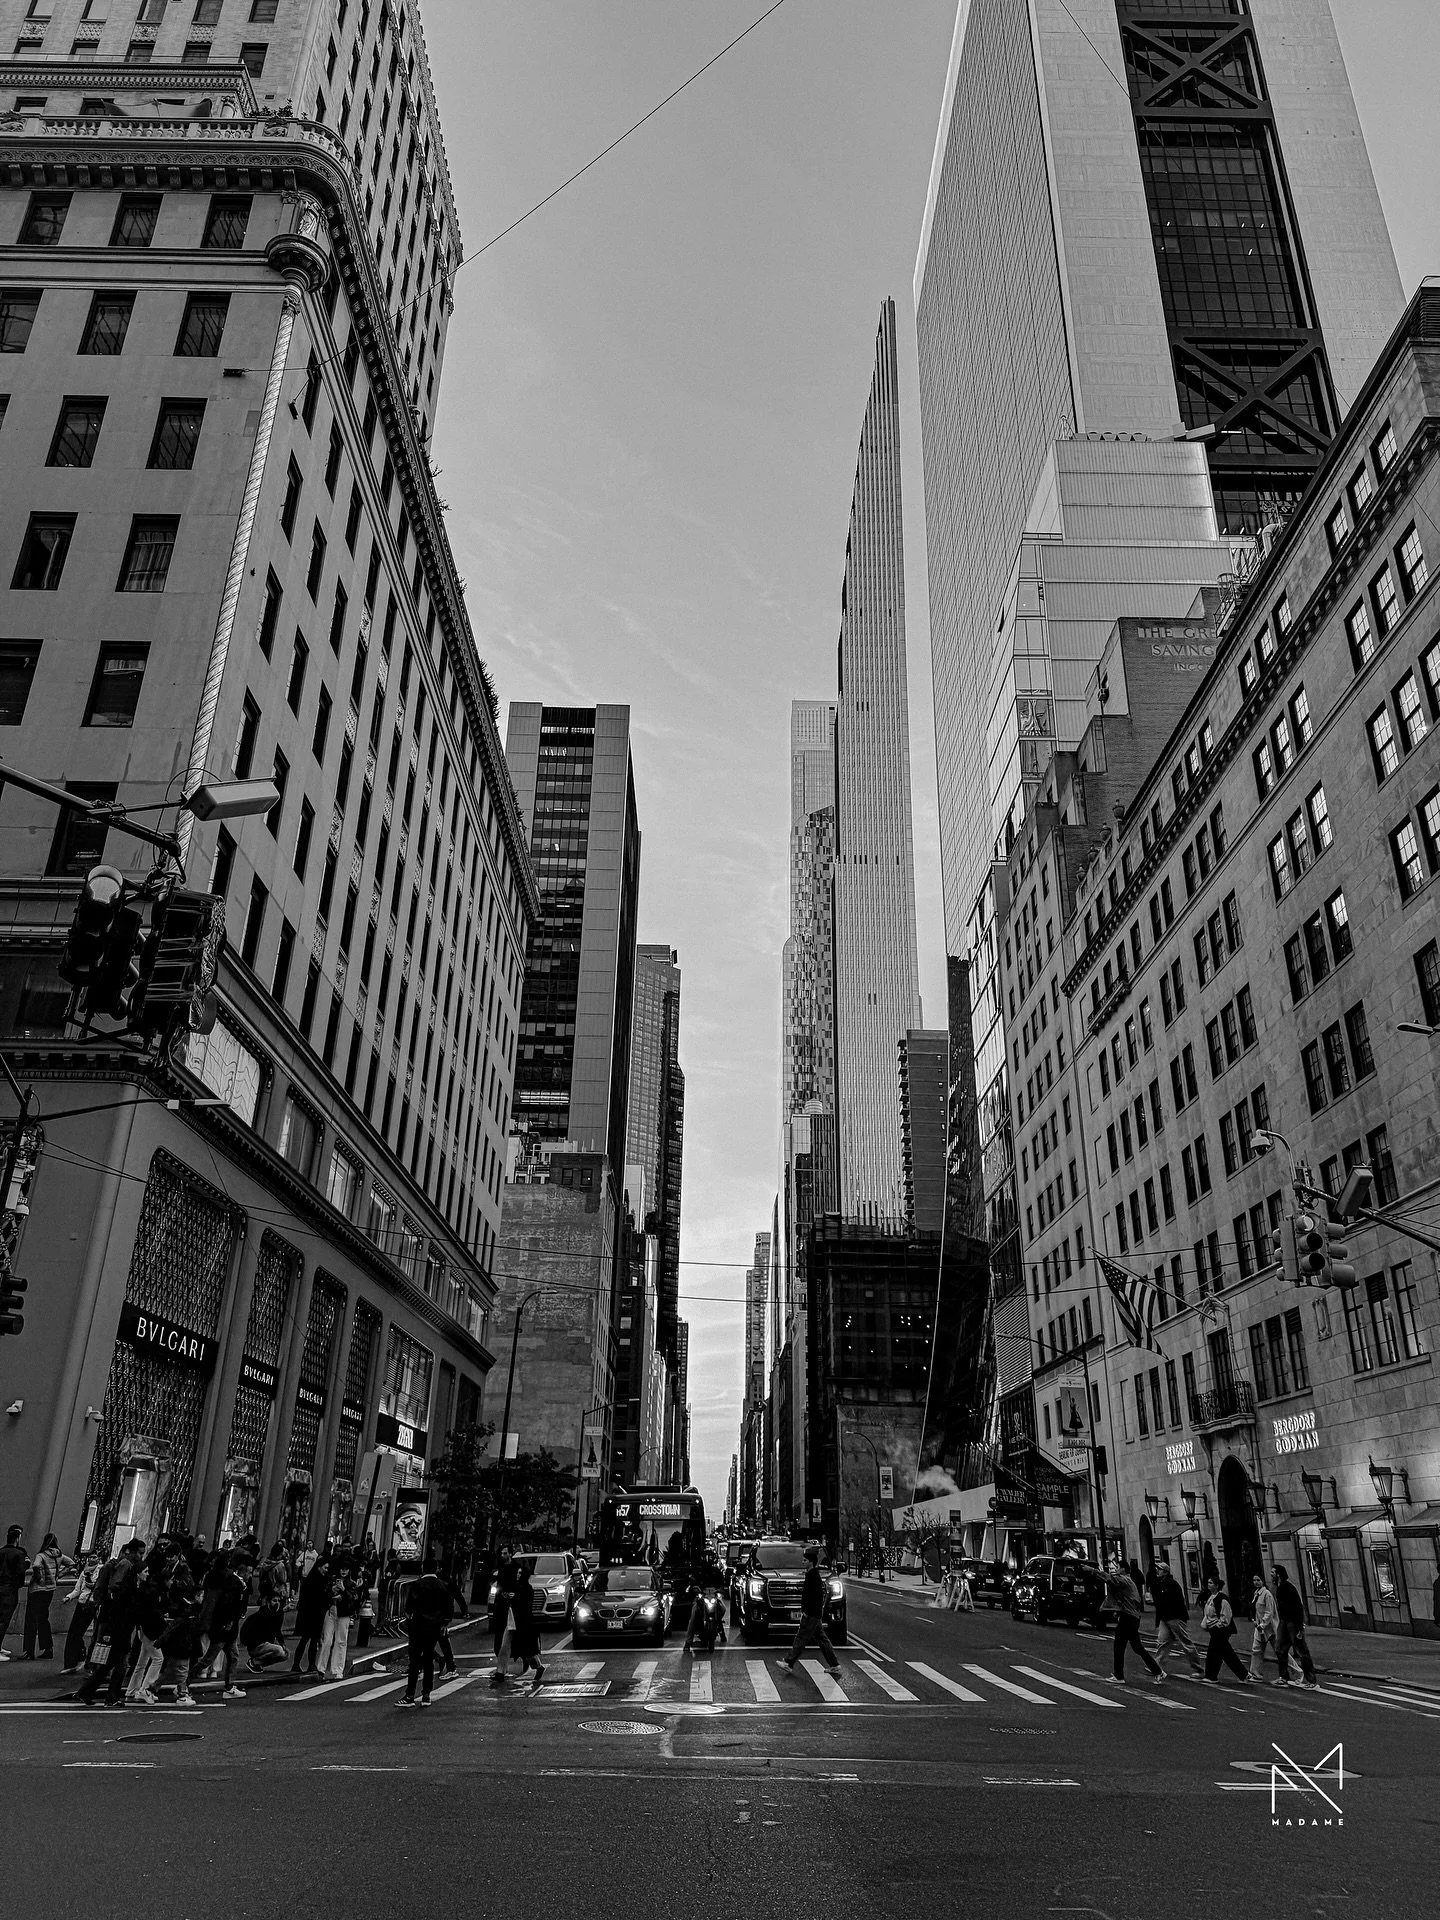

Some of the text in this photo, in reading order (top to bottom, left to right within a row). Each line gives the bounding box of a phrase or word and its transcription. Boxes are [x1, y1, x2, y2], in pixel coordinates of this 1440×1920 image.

[1138, 627, 1174, 638] THE
[1151, 644, 1215, 656] SAVING
[137, 1317, 206, 1361] BVLGARI
[244, 1365, 274, 1386] BVLGARI
[299, 1388, 323, 1405] BVLGARI
[1272, 1412, 1315, 1437] BERGDORF
[1165, 1441, 1193, 1460] BERGDORF
[1275, 1431, 1320, 1454] GOODMAN
[1167, 1456, 1196, 1475] GOODMAN
[1036, 1483, 1070, 1494] SAMPLE
[1037, 1492, 1060, 1501] SALE
[639, 1504, 681, 1515] CROSSTOWN
